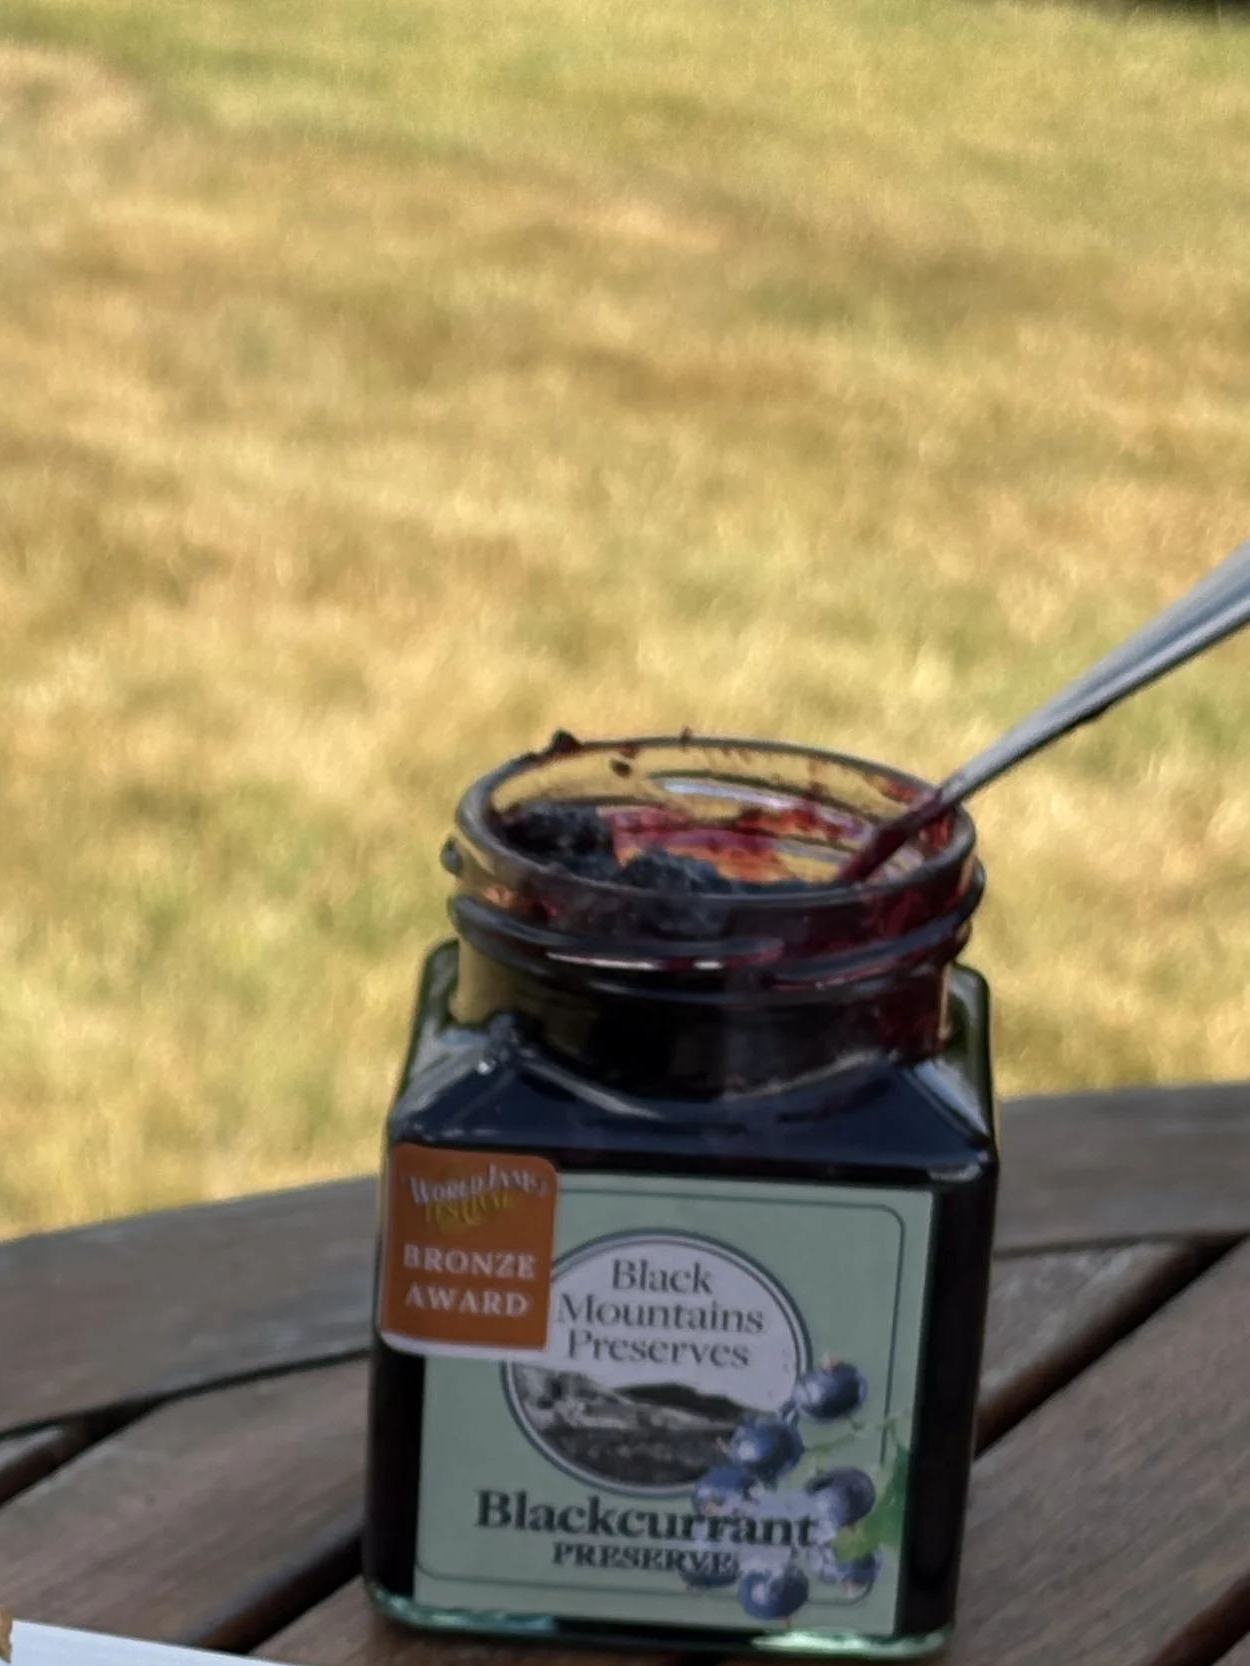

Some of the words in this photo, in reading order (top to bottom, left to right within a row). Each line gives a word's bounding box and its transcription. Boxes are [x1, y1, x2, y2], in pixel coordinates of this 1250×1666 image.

[403, 1243, 536, 1279] BRONZE
[612, 1258, 713, 1296] Black
[405, 1281, 530, 1319] AWARD
[557, 1292, 765, 1335] Mountains
[567, 1328, 751, 1368] Preserves
[474, 1489, 817, 1547] Blackcurrant
